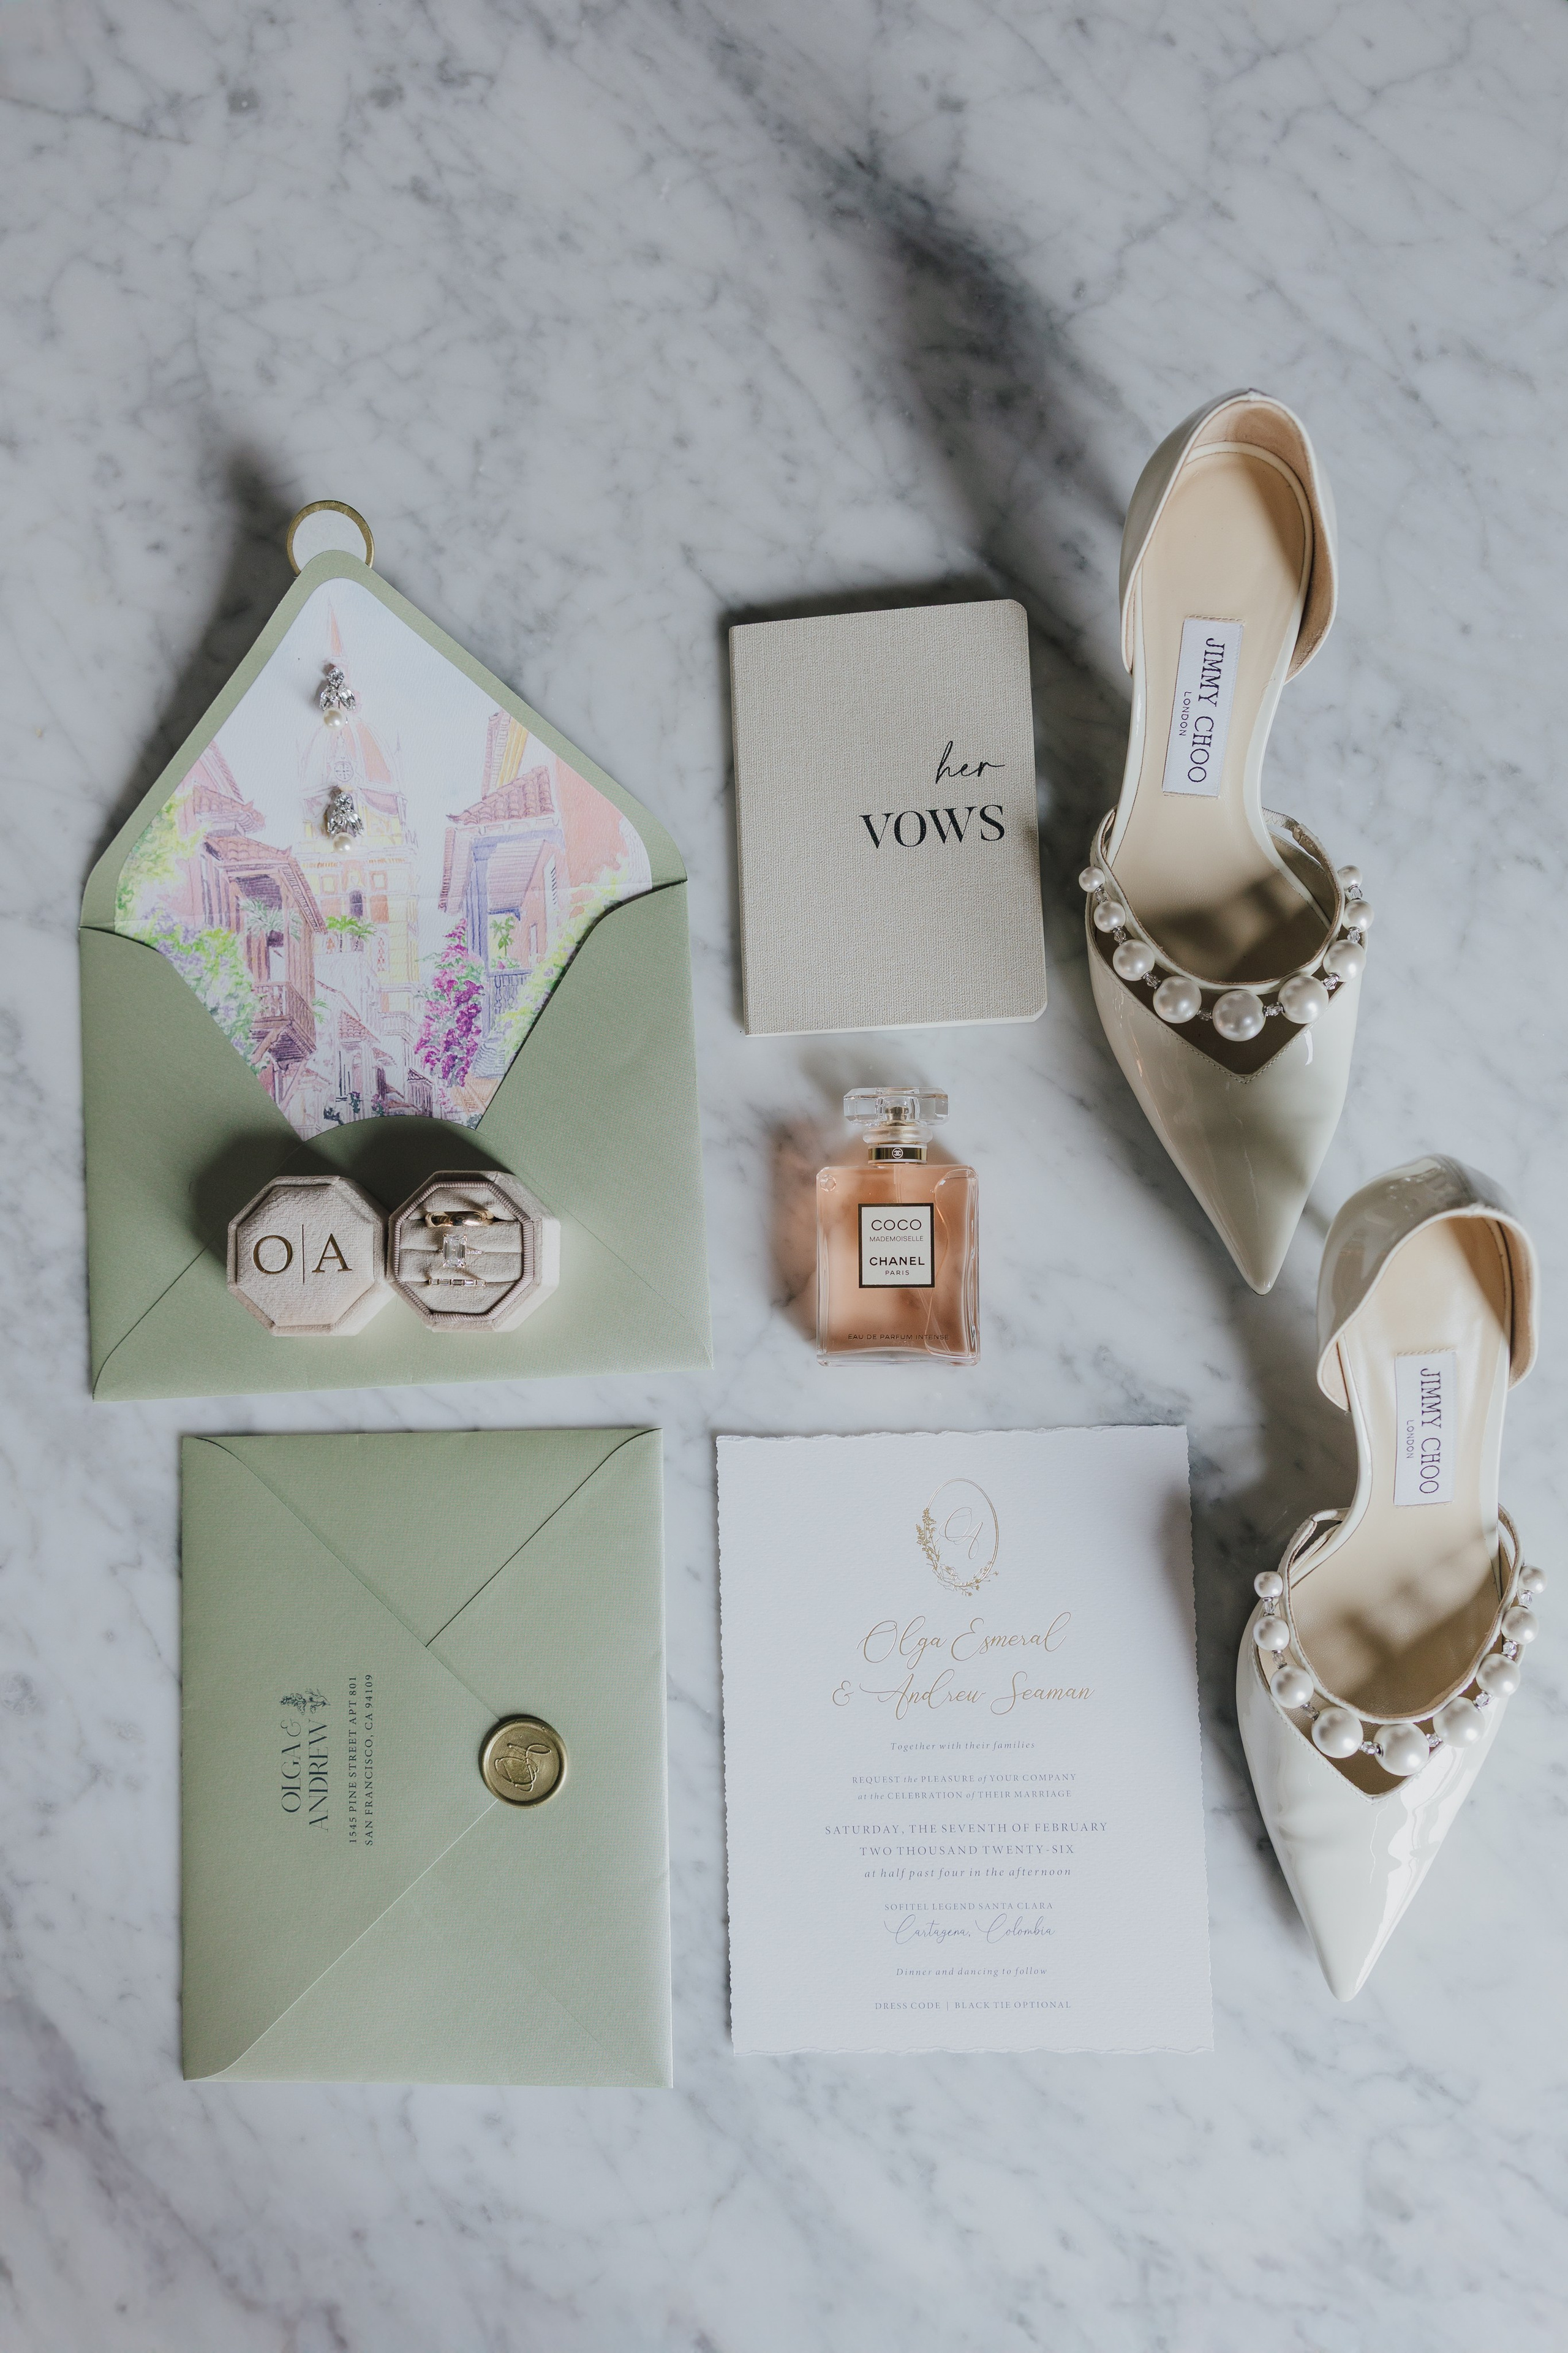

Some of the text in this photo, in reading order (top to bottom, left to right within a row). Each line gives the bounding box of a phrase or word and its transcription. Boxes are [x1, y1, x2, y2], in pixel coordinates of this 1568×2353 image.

[1179, 692, 1191, 736] LONDON
[1188, 638, 1225, 782] JIMMY CHOO
[935, 741, 1005, 784] her
[859, 805, 1005, 849] VOWS
[872, 1219, 922, 1231] COCO
[870, 1256, 925, 1266] CHANEL
[1420, 1368, 1441, 1494] JIMMY CHOO
[856, 1612, 1071, 1669] Olga Esmeral
[859, 1669, 986, 1720] Andrew
[990, 1671, 1096, 1715] Seaman
[348, 1701, 356, 1725] APT
[365, 1713, 373, 1730] CA
[348, 1731, 356, 1777] STREET
[891, 1741, 1035, 1751] Together with their families
[281, 1742, 301, 1813] OLGA
[309, 1720, 328, 1832] ANDREW
[365, 1735, 374, 1814] FRANCISCO,
[978, 1775, 987, 1784] of
[348, 1783, 356, 1812] PINE
[966, 1791, 976, 1800] of
[825, 1822, 1107, 1835] SATURDAY, THE SEVENTH OF FEBRUARY
[859, 1845, 1074, 1856] TWO THOUSAND TWENTY-SIX
[880, 1867, 906, 1880] half
[909, 1870, 934, 1880] past
[938, 1867, 965, 1879] four
[969, 1867, 981, 1877] in
[985, 1867, 1005, 1876] the
[1009, 1866, 1071, 1880] afternoon
[883, 1914, 1055, 1945] Cartagena, Colombia
[896, 1968, 932, 1976] Dinner
[957, 1967, 998, 1977] dancing
[1014, 1966, 1047, 1977] follow
